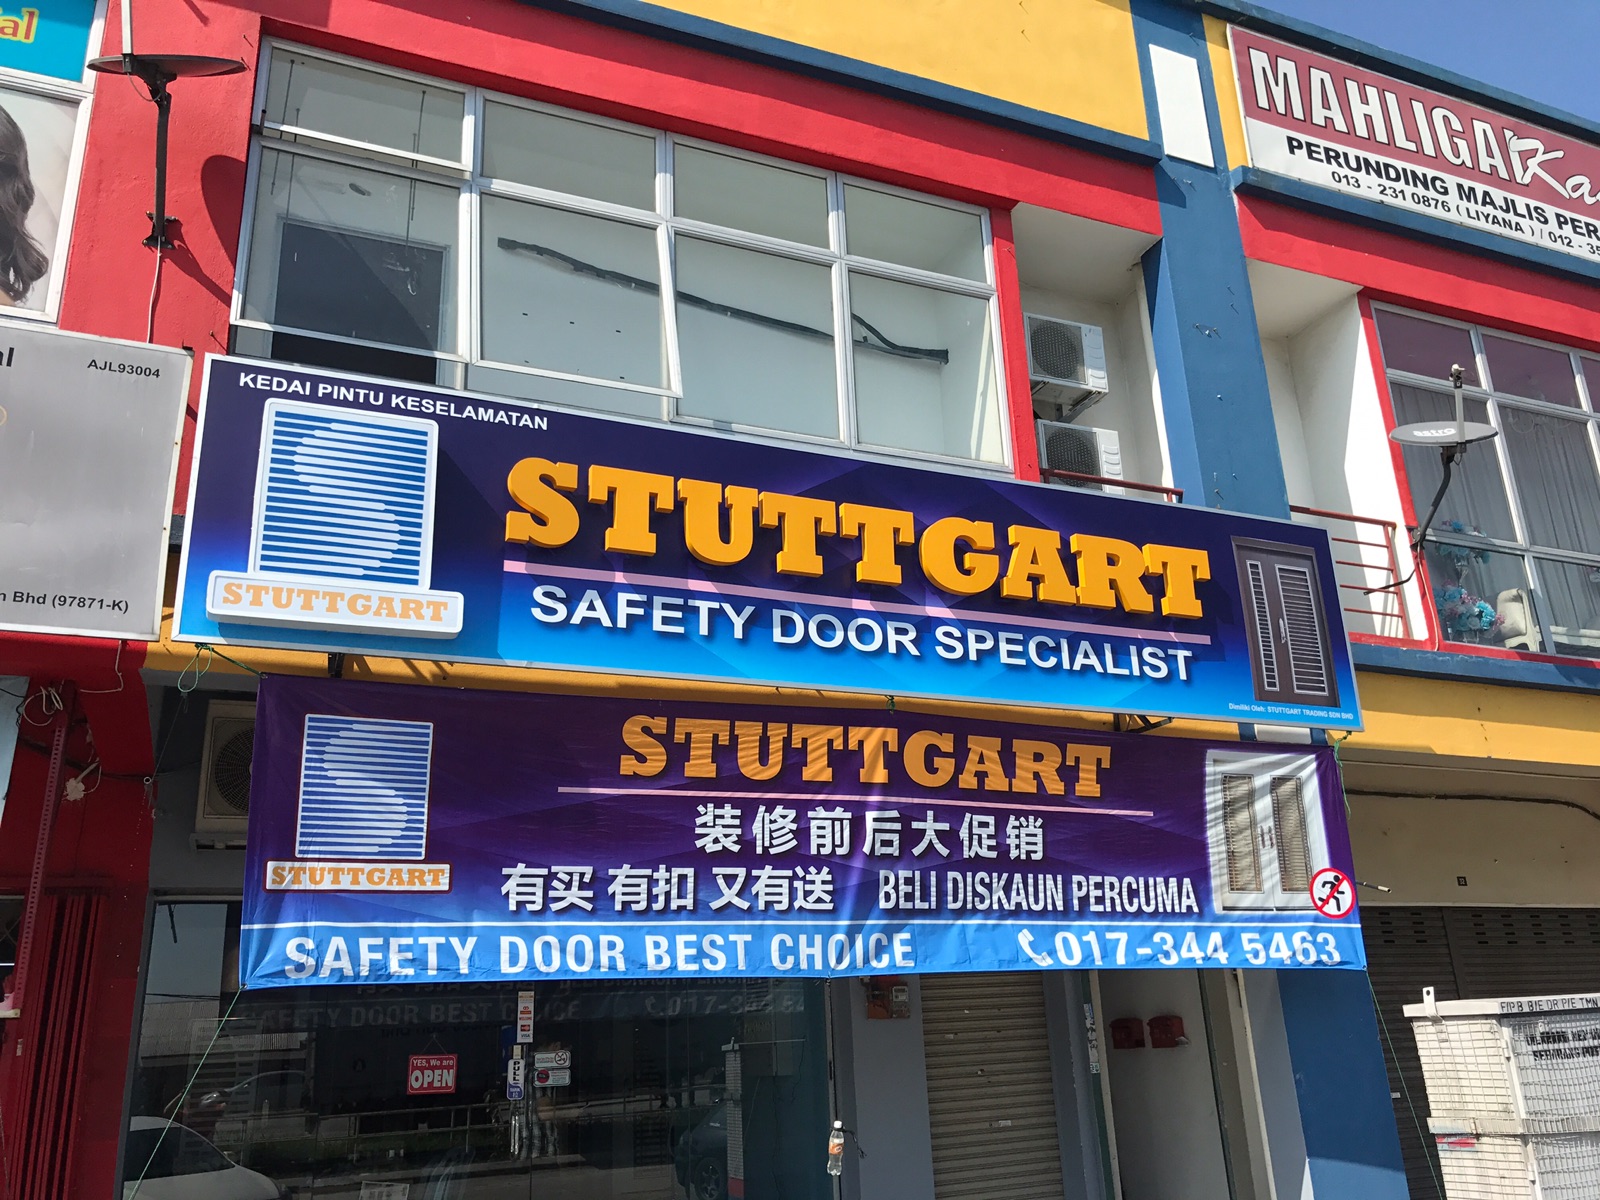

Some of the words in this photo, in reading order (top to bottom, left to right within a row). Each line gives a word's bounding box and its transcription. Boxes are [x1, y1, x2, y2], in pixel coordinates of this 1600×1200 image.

[1285, 135, 1450, 197] PERUNDING
[1456, 182, 1549, 227] MAJLIS
[1331, 170, 1362, 190] 013
[1377, 183, 1407, 204] 231
[1411, 191, 1451, 214] 0876
[1466, 208, 1525, 236] LIYANA
[1548, 231, 1575, 249] 012
[87, 358, 161, 379] AJL93004
[238, 372, 312, 396] KEDAI
[317, 384, 384, 406] PINTU
[390, 393, 549, 431] KESELAMATAN
[504, 457, 1211, 619] STUTTGART
[12, 591, 47, 605] Bhd
[52, 594, 129, 615] (97871-K)
[222, 581, 449, 623] STUTTGART
[530, 584, 756, 640] SAFETY
[771, 607, 921, 656] DOOR
[934, 624, 1193, 681] SPECIALIST
[1267, 706, 1302, 716] STUTTGART
[1303, 709, 1328, 718] TRADING
[1329, 711, 1341, 719] SDN
[1341, 712, 1354, 720] BHD
[619, 714, 1111, 798] STUTTGART
[694, 803, 1045, 861] 装修前后大促销
[271, 865, 445, 887] STUTTGART
[500, 862, 594, 913] 有买
[607, 863, 695, 912] 有扣
[708, 865, 834, 912] 又有送
[878, 869, 938, 910] BELI
[947, 871, 1064, 912] DISKAUN
[1071, 874, 1199, 914] PERCUMA
[284, 936, 478, 980] SAFETY
[500, 934, 626, 974] DOOR
[645, 933, 752, 973] BEST
[770, 932, 916, 972] CHOICE
[1054, 930, 1229, 966] 017-344
[1241, 931, 1341, 967] 5463
[411, 1069, 454, 1089] OPEN
[413, 1059, 429, 1068] YES,
[512, 1060, 521, 1082] PULL
